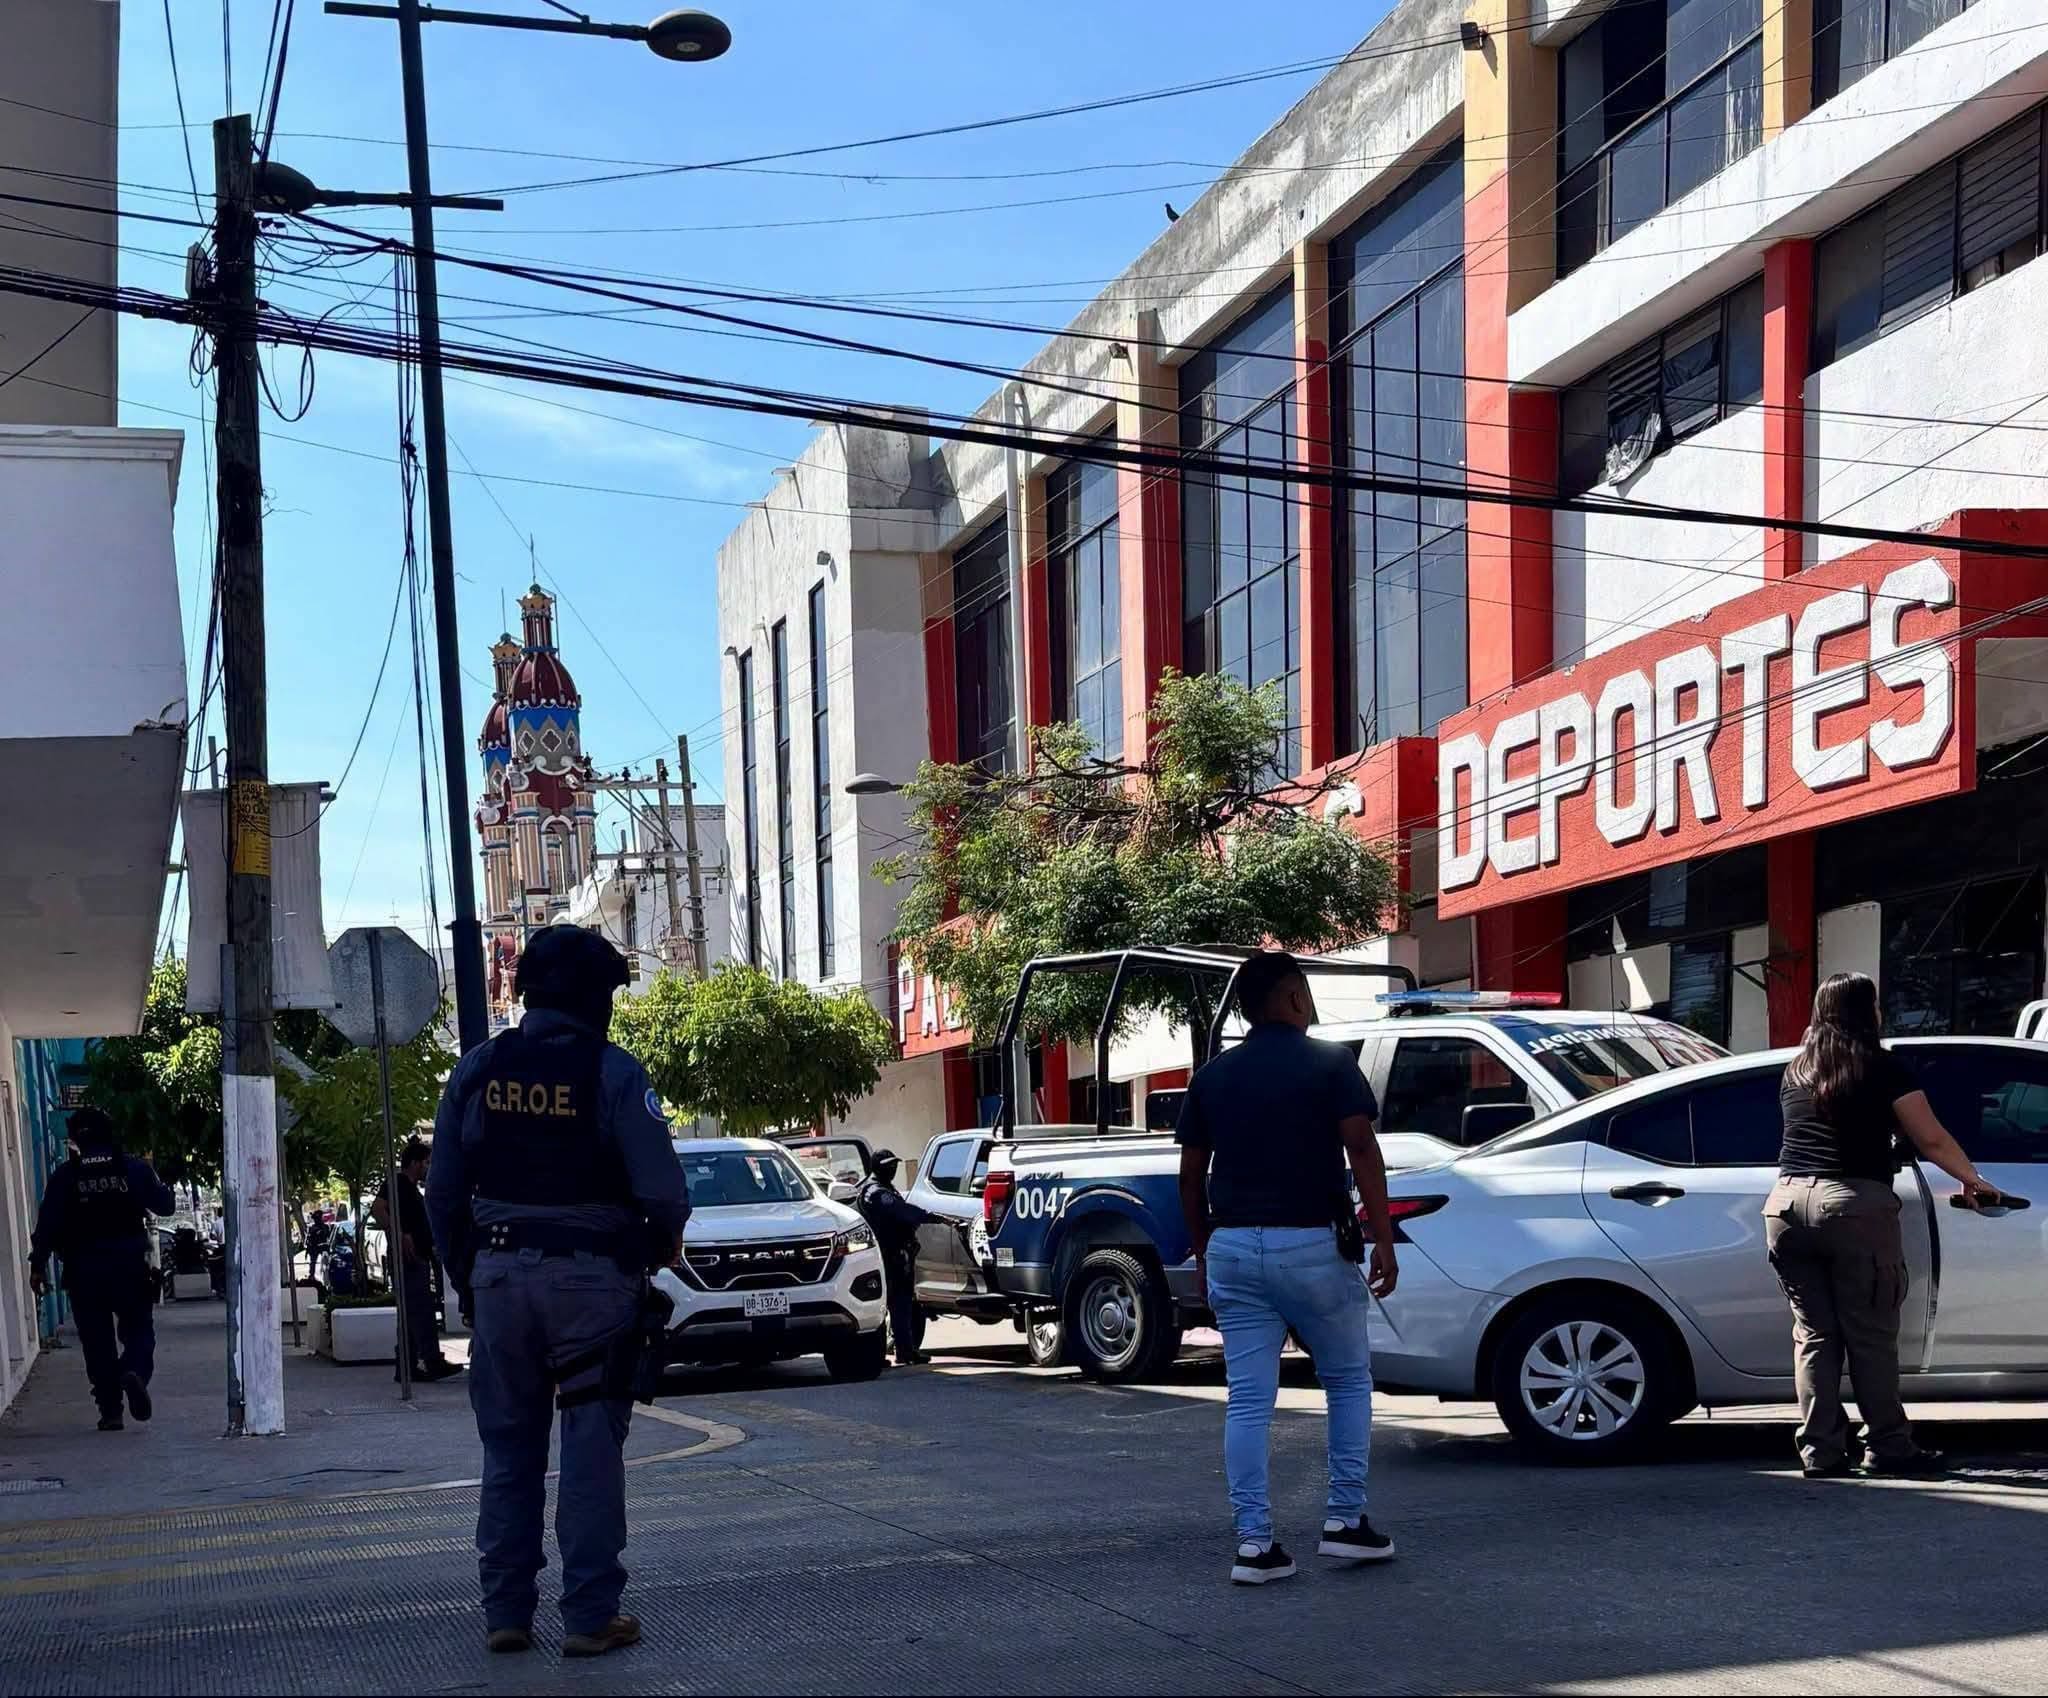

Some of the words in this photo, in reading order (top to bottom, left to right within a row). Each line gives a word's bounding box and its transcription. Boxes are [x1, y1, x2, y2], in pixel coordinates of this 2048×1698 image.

[1439, 557, 1954, 890] DEPORTES
[898, 955, 962, 1044] PAL
[486, 1079, 577, 1117] G.R.O.E.
[1015, 1187, 1073, 1219] 0047
[729, 1249, 796, 1263] RAM
